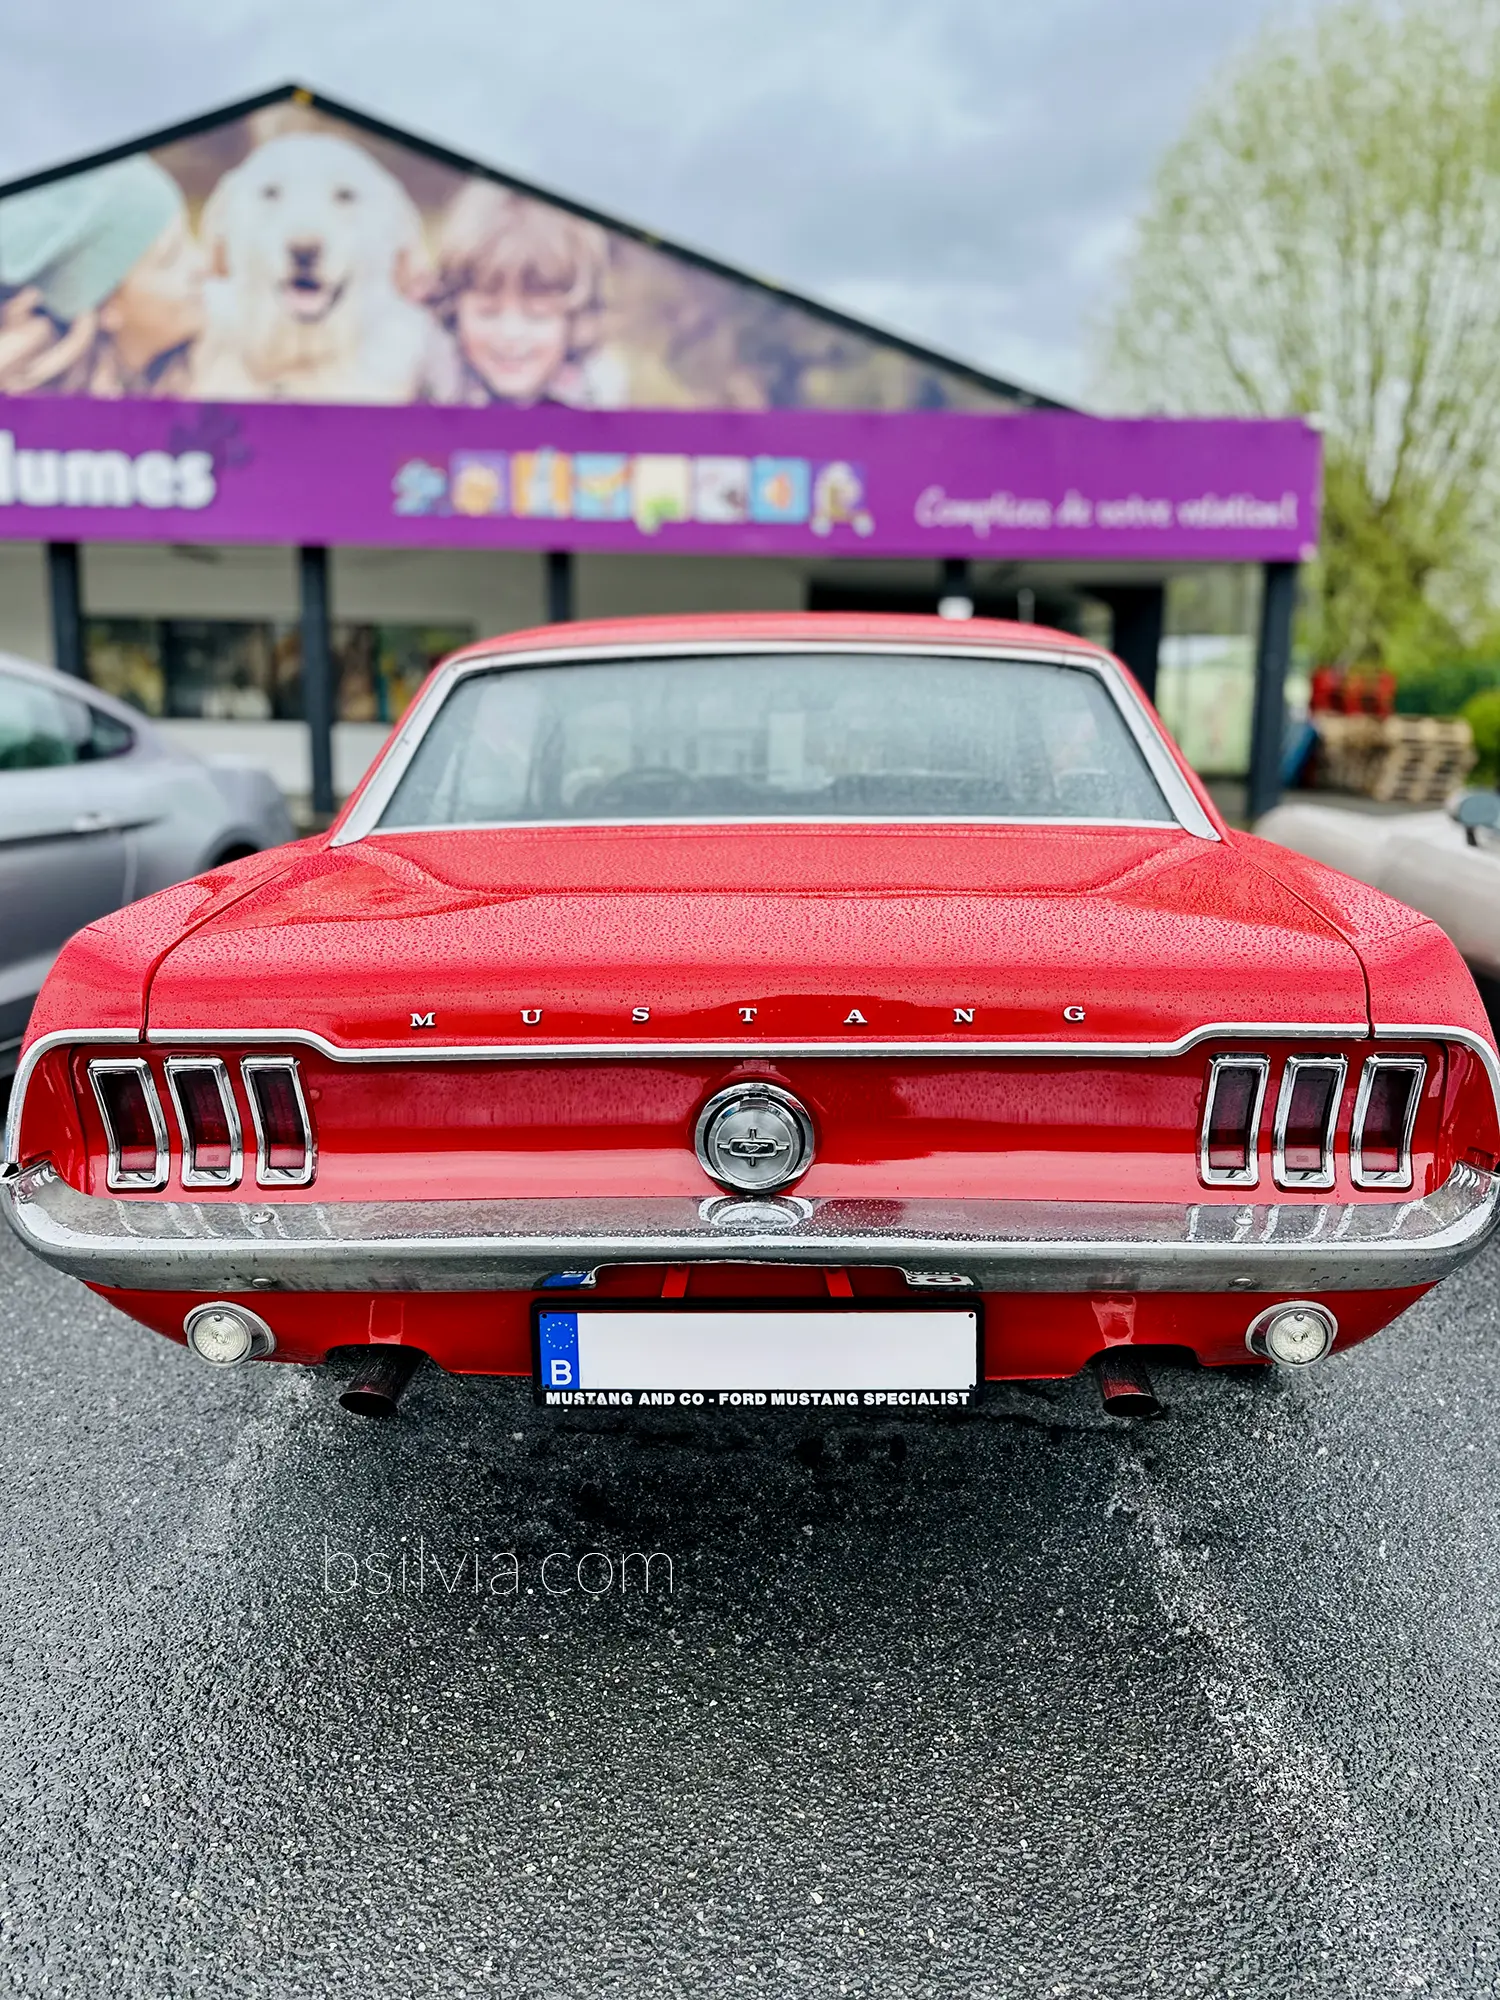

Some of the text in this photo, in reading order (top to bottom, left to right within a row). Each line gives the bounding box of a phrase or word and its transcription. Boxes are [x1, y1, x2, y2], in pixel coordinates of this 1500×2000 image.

[1054, 489, 1091, 529] de
[550, 1360, 573, 1386] B
[546, 1392, 633, 1405] MUSTANG
[639, 1392, 675, 1405] AND
[679, 1392, 705, 1406] CO
[719, 1392, 767, 1406] FORD
[771, 1392, 859, 1406] MUSTANG
[863, 1392, 970, 1406] SPECIALIST
